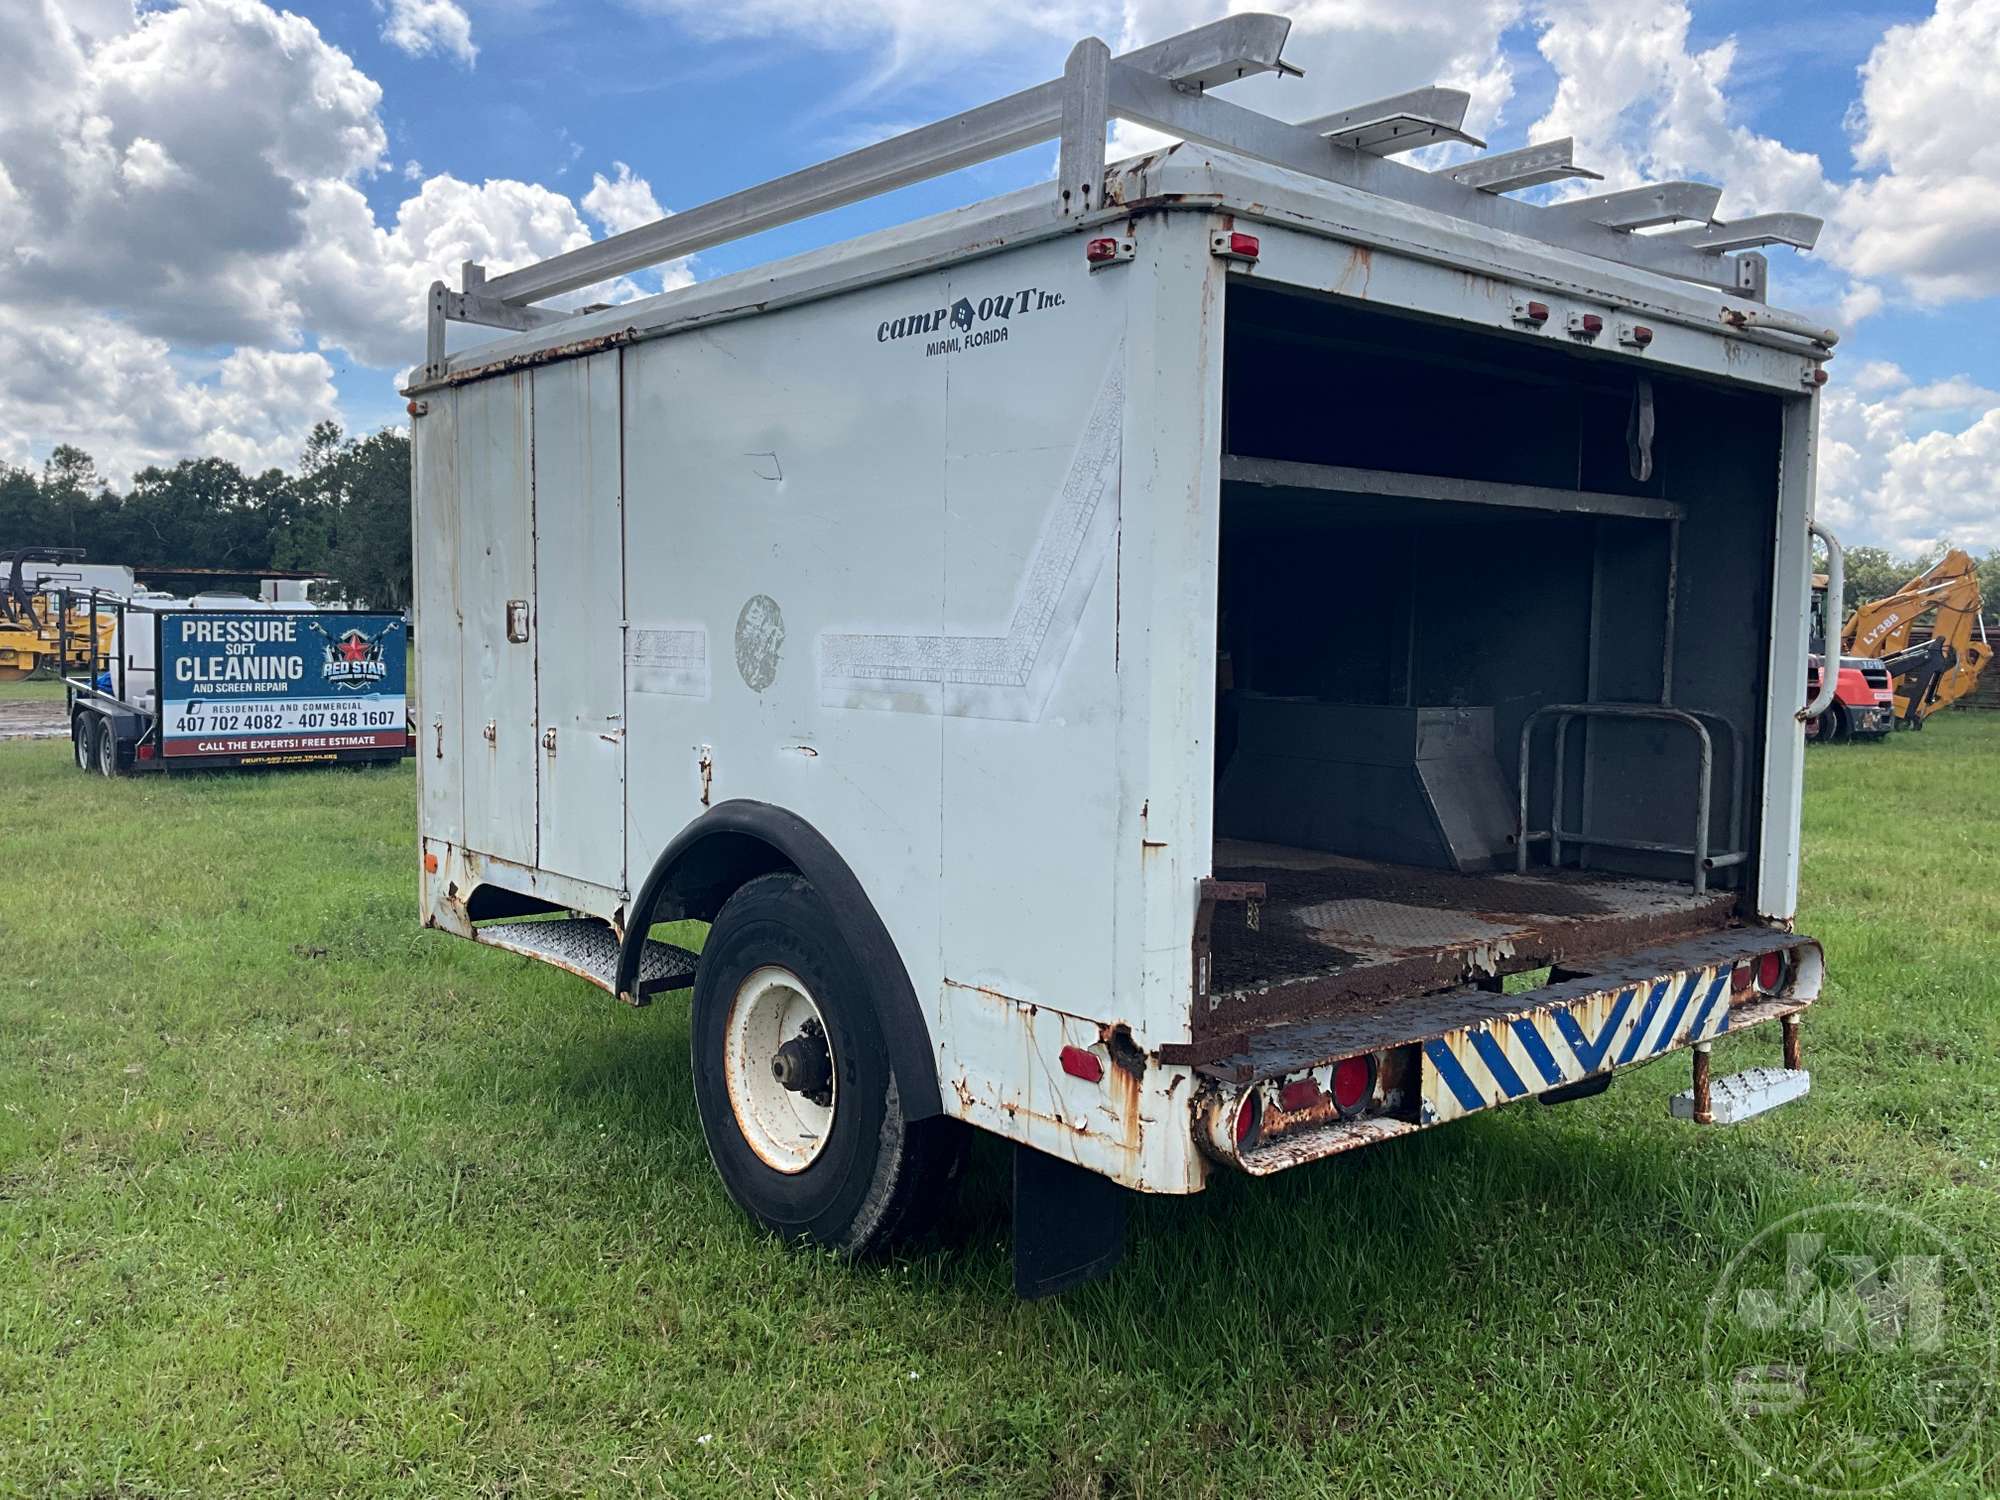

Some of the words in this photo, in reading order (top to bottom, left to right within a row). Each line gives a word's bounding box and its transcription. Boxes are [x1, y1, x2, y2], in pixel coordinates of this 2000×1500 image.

[926, 337, 961, 357] MIAMI,
[965, 327, 1008, 349] FLORIDA
[182, 621, 297, 642] PRESSURE
[225, 643, 256, 655] SOFT
[176, 656, 303, 681] CLEANING
[323, 661, 349, 676] RED
[352, 661, 386, 675] STAR
[193, 683, 213, 693] AND
[215, 683, 252, 692] SCREEN
[255, 682, 288, 692] REPAIR
[212, 704, 274, 714] RESIDENTIAL
[280, 703, 298, 712] AND
[303, 702, 362, 711] COMMERCIAL
[176, 716, 205, 732] 407
[210, 715, 238, 731] 702
[244, 714, 282, 730] 4082
[298, 713, 325, 728] 407
[330, 712, 357, 727] 948
[362, 711, 395, 726] 1607
[198, 742, 225, 752] CALL
[227, 741, 247, 750] THE
[250, 739, 299, 749] EXPERTS!
[301, 738, 326, 747] FREE
[329, 736, 376, 746] ESTIMATE
